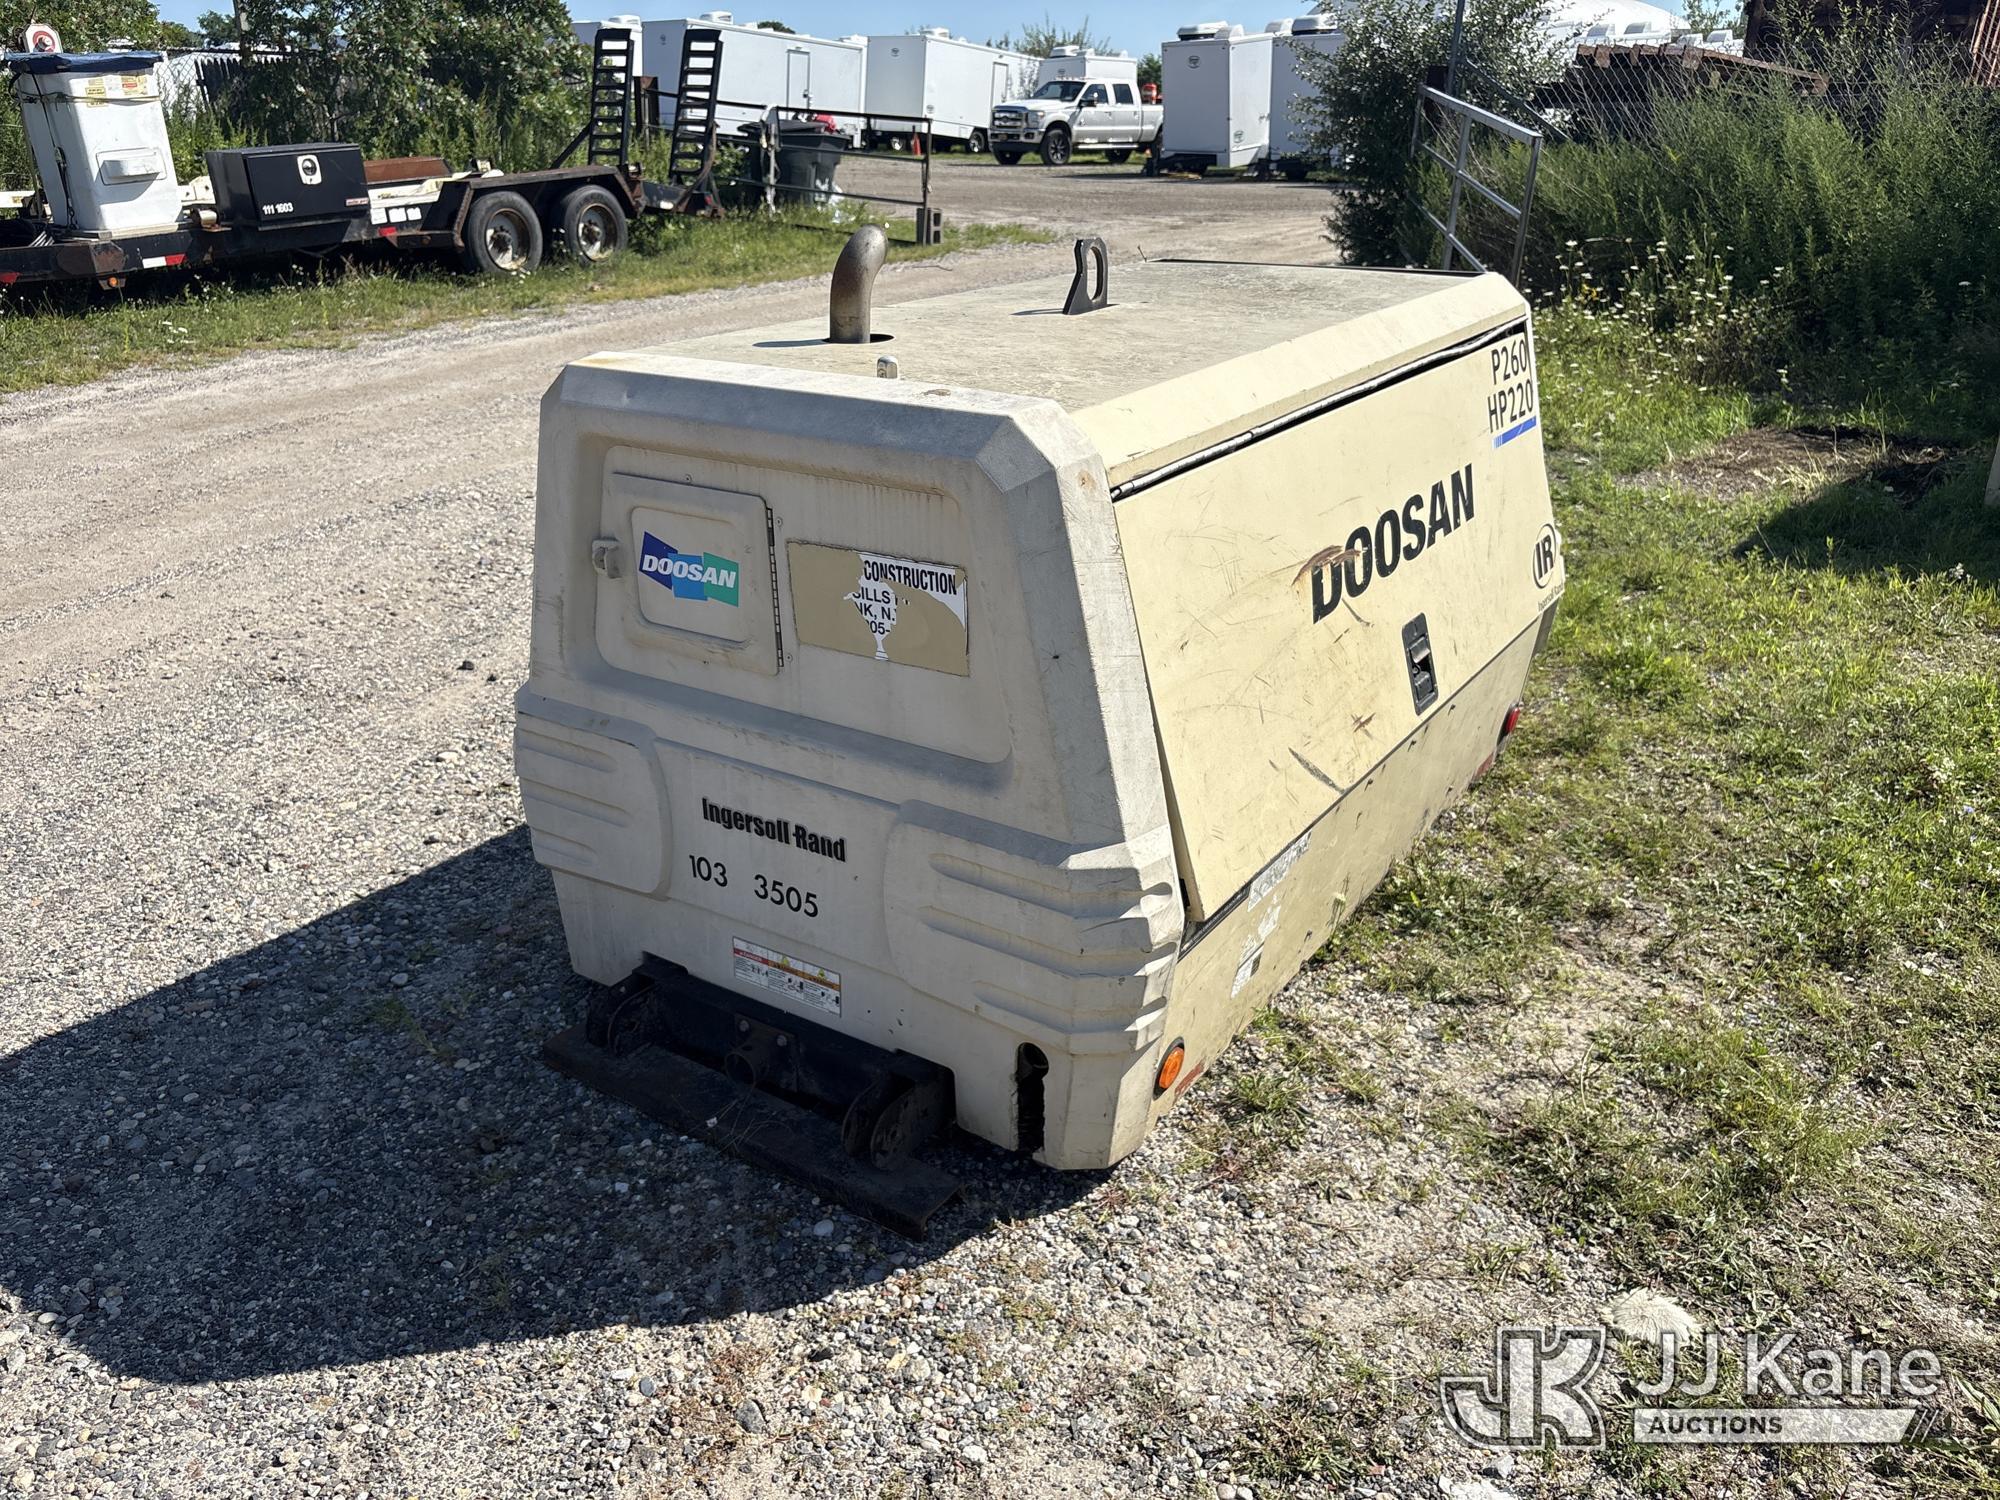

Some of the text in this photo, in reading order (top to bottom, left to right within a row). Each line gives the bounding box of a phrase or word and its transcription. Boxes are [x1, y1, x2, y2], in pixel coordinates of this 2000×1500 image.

[1491, 339, 1527, 385] P260
[1487, 378, 1534, 434] HP220
[1311, 463, 1475, 624] DOOSAN
[1535, 534, 1554, 580] IR
[642, 554, 736, 588] DOOSAN
[864, 560, 957, 595] CONSTRUCTION
[689, 854, 819, 918] 103 3505
